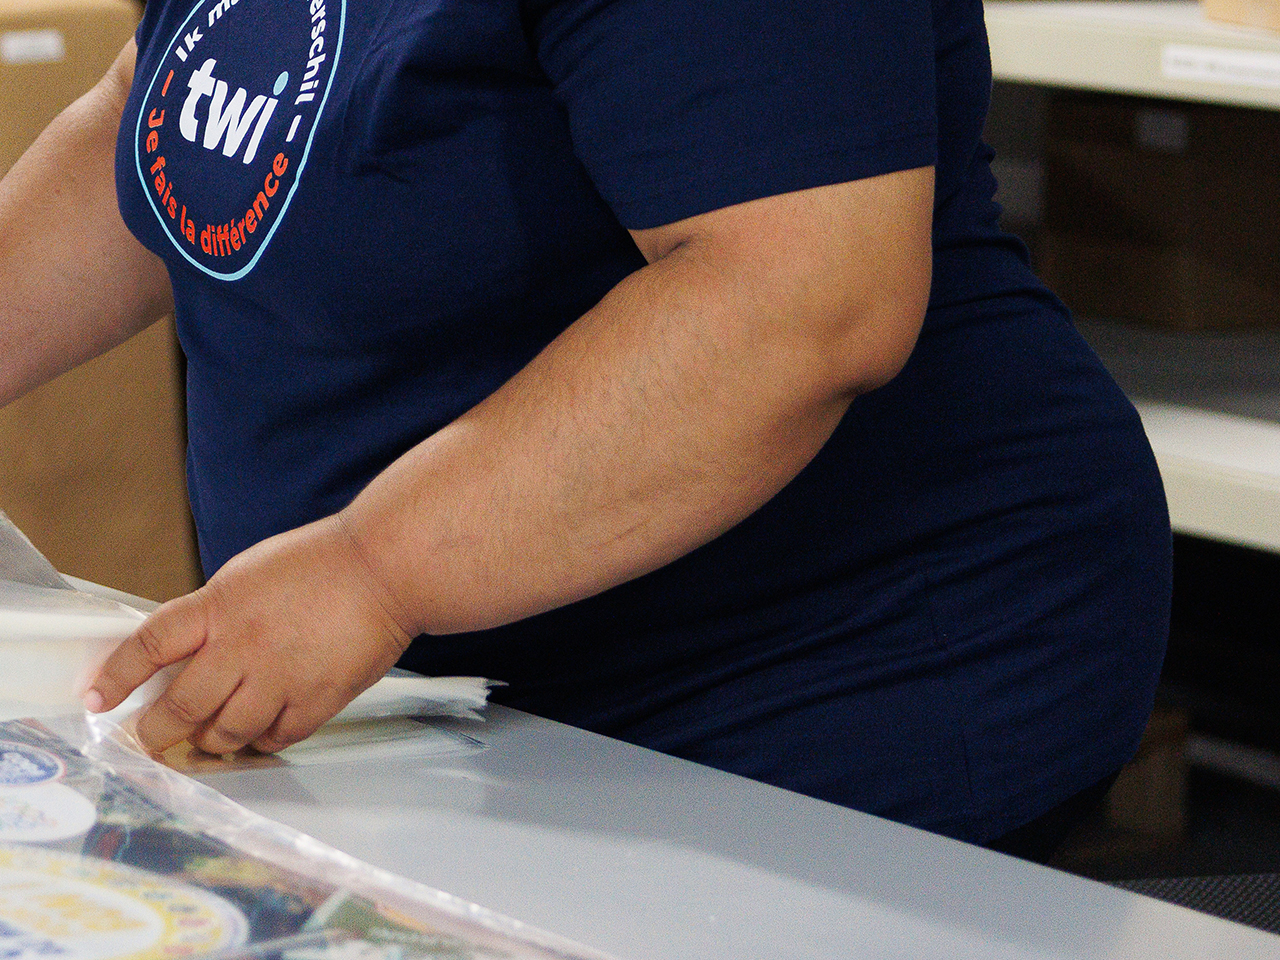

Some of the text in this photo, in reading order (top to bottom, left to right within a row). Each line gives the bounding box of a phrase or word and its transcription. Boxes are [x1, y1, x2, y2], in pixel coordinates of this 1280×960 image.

[174, 28, 203, 63] Ik
[179, 57, 290, 165] twi
[146, 107, 289, 257] Je fais la différence
